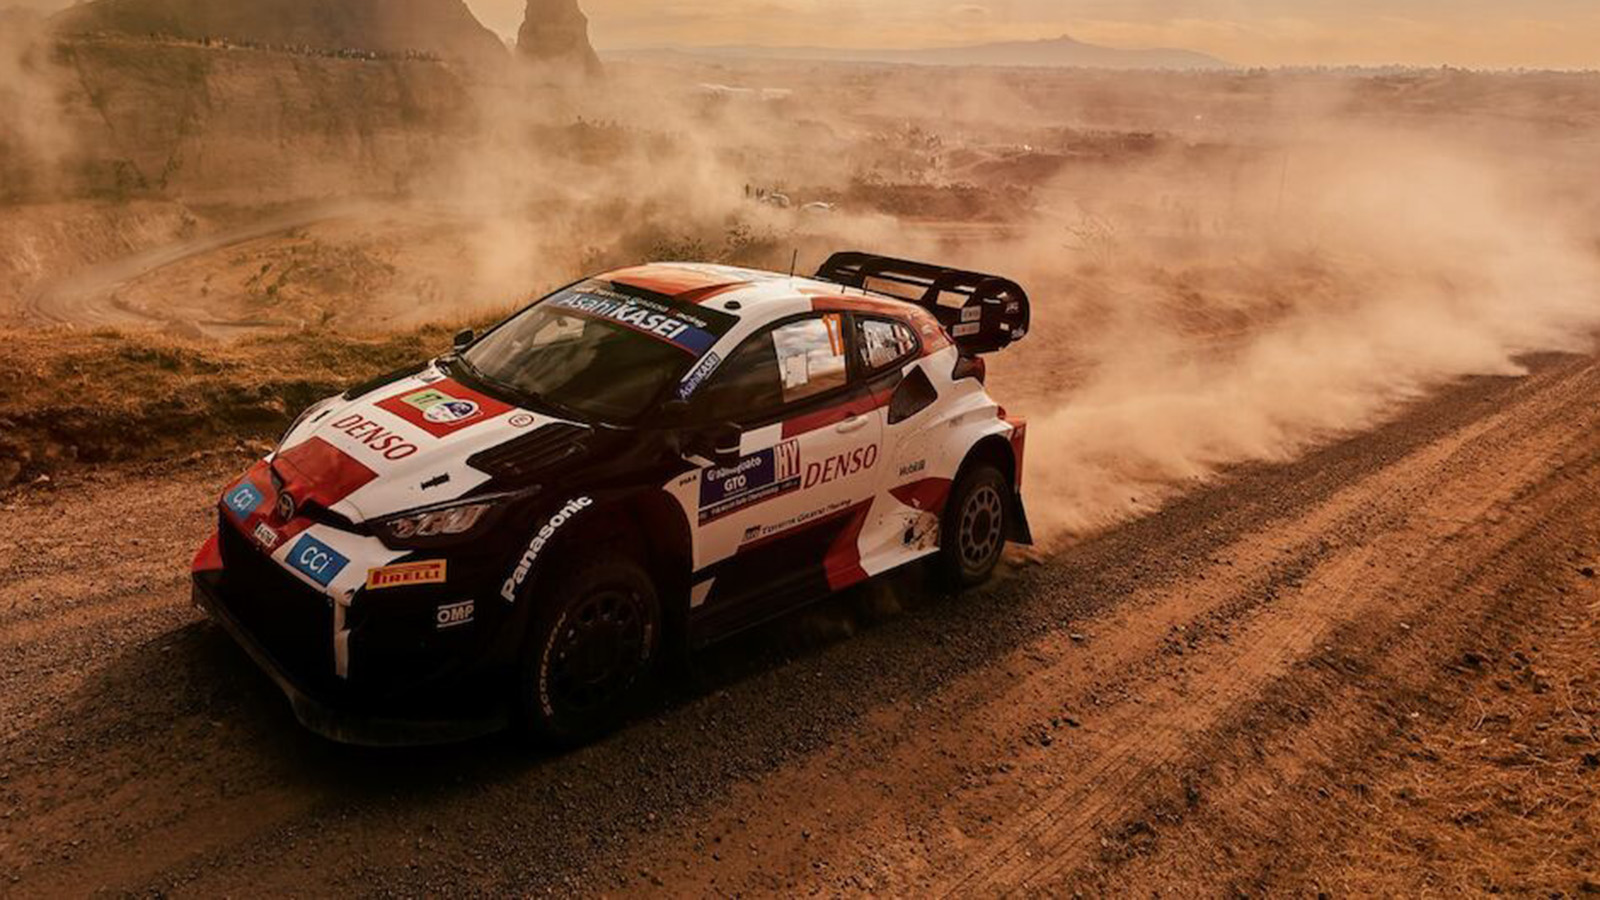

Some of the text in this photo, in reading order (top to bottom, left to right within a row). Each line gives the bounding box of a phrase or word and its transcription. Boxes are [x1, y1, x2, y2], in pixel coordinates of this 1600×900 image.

[561, 293, 689, 339] AsahiKASEI
[679, 353, 718, 400] AsahiKASEI
[331, 413, 420, 462] DENSO
[723, 474, 747, 492] GTO
[803, 443, 877, 490] DENSO
[499, 495, 594, 604] Panasonic
[372, 563, 440, 585] PIRELLI
[436, 604, 475, 623] OMP
